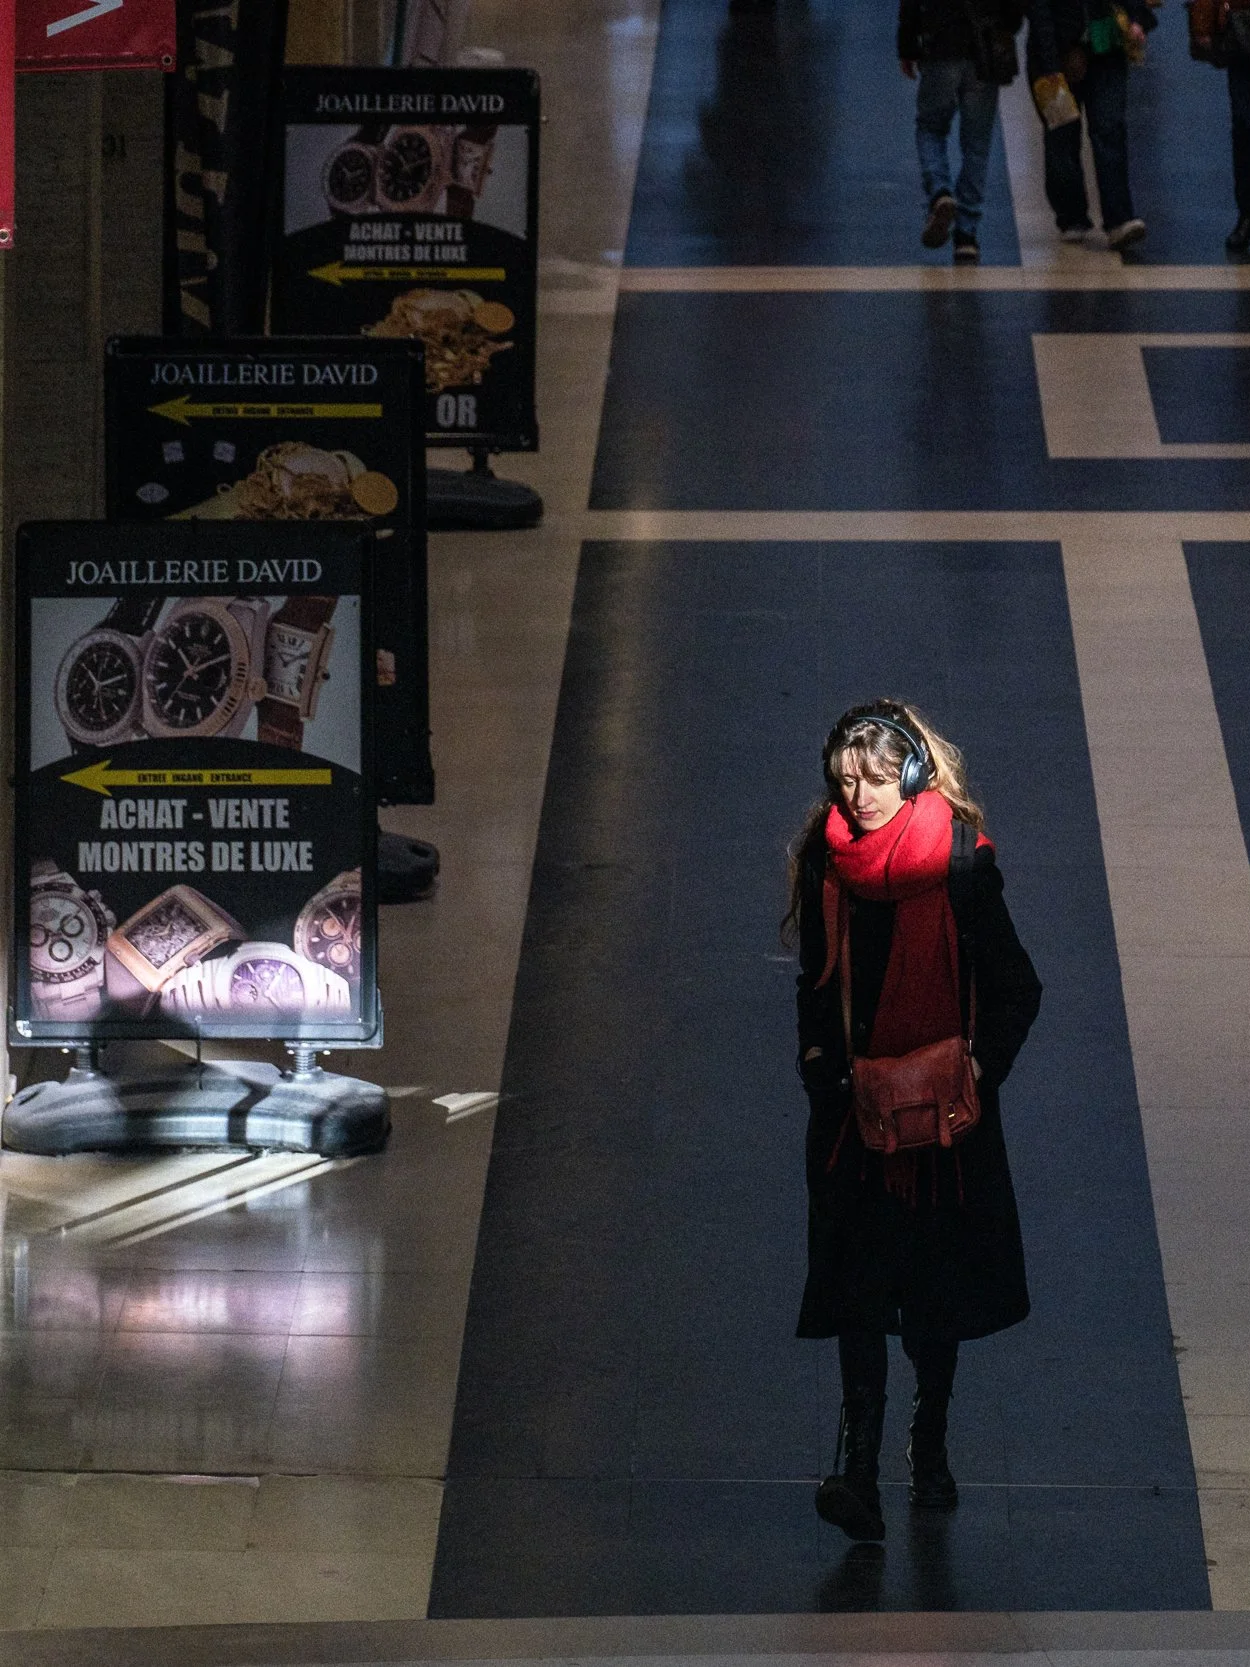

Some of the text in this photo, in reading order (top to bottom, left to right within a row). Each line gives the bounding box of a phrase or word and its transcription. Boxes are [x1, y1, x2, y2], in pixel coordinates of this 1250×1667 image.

[315, 94, 506, 113] JOAILLERIE DAVID
[349, 222, 402, 241] ACHAT
[414, 222, 464, 241] VENTE
[150, 363, 379, 386] JOAILLERIE DAVID
[436, 393, 478, 428] OR
[66, 558, 323, 585] JOAILLERIE DAVID
[100, 798, 188, 830] ACHAT
[208, 798, 290, 829] VENTE
[78, 841, 314, 873] MONTRES DE LUXE
